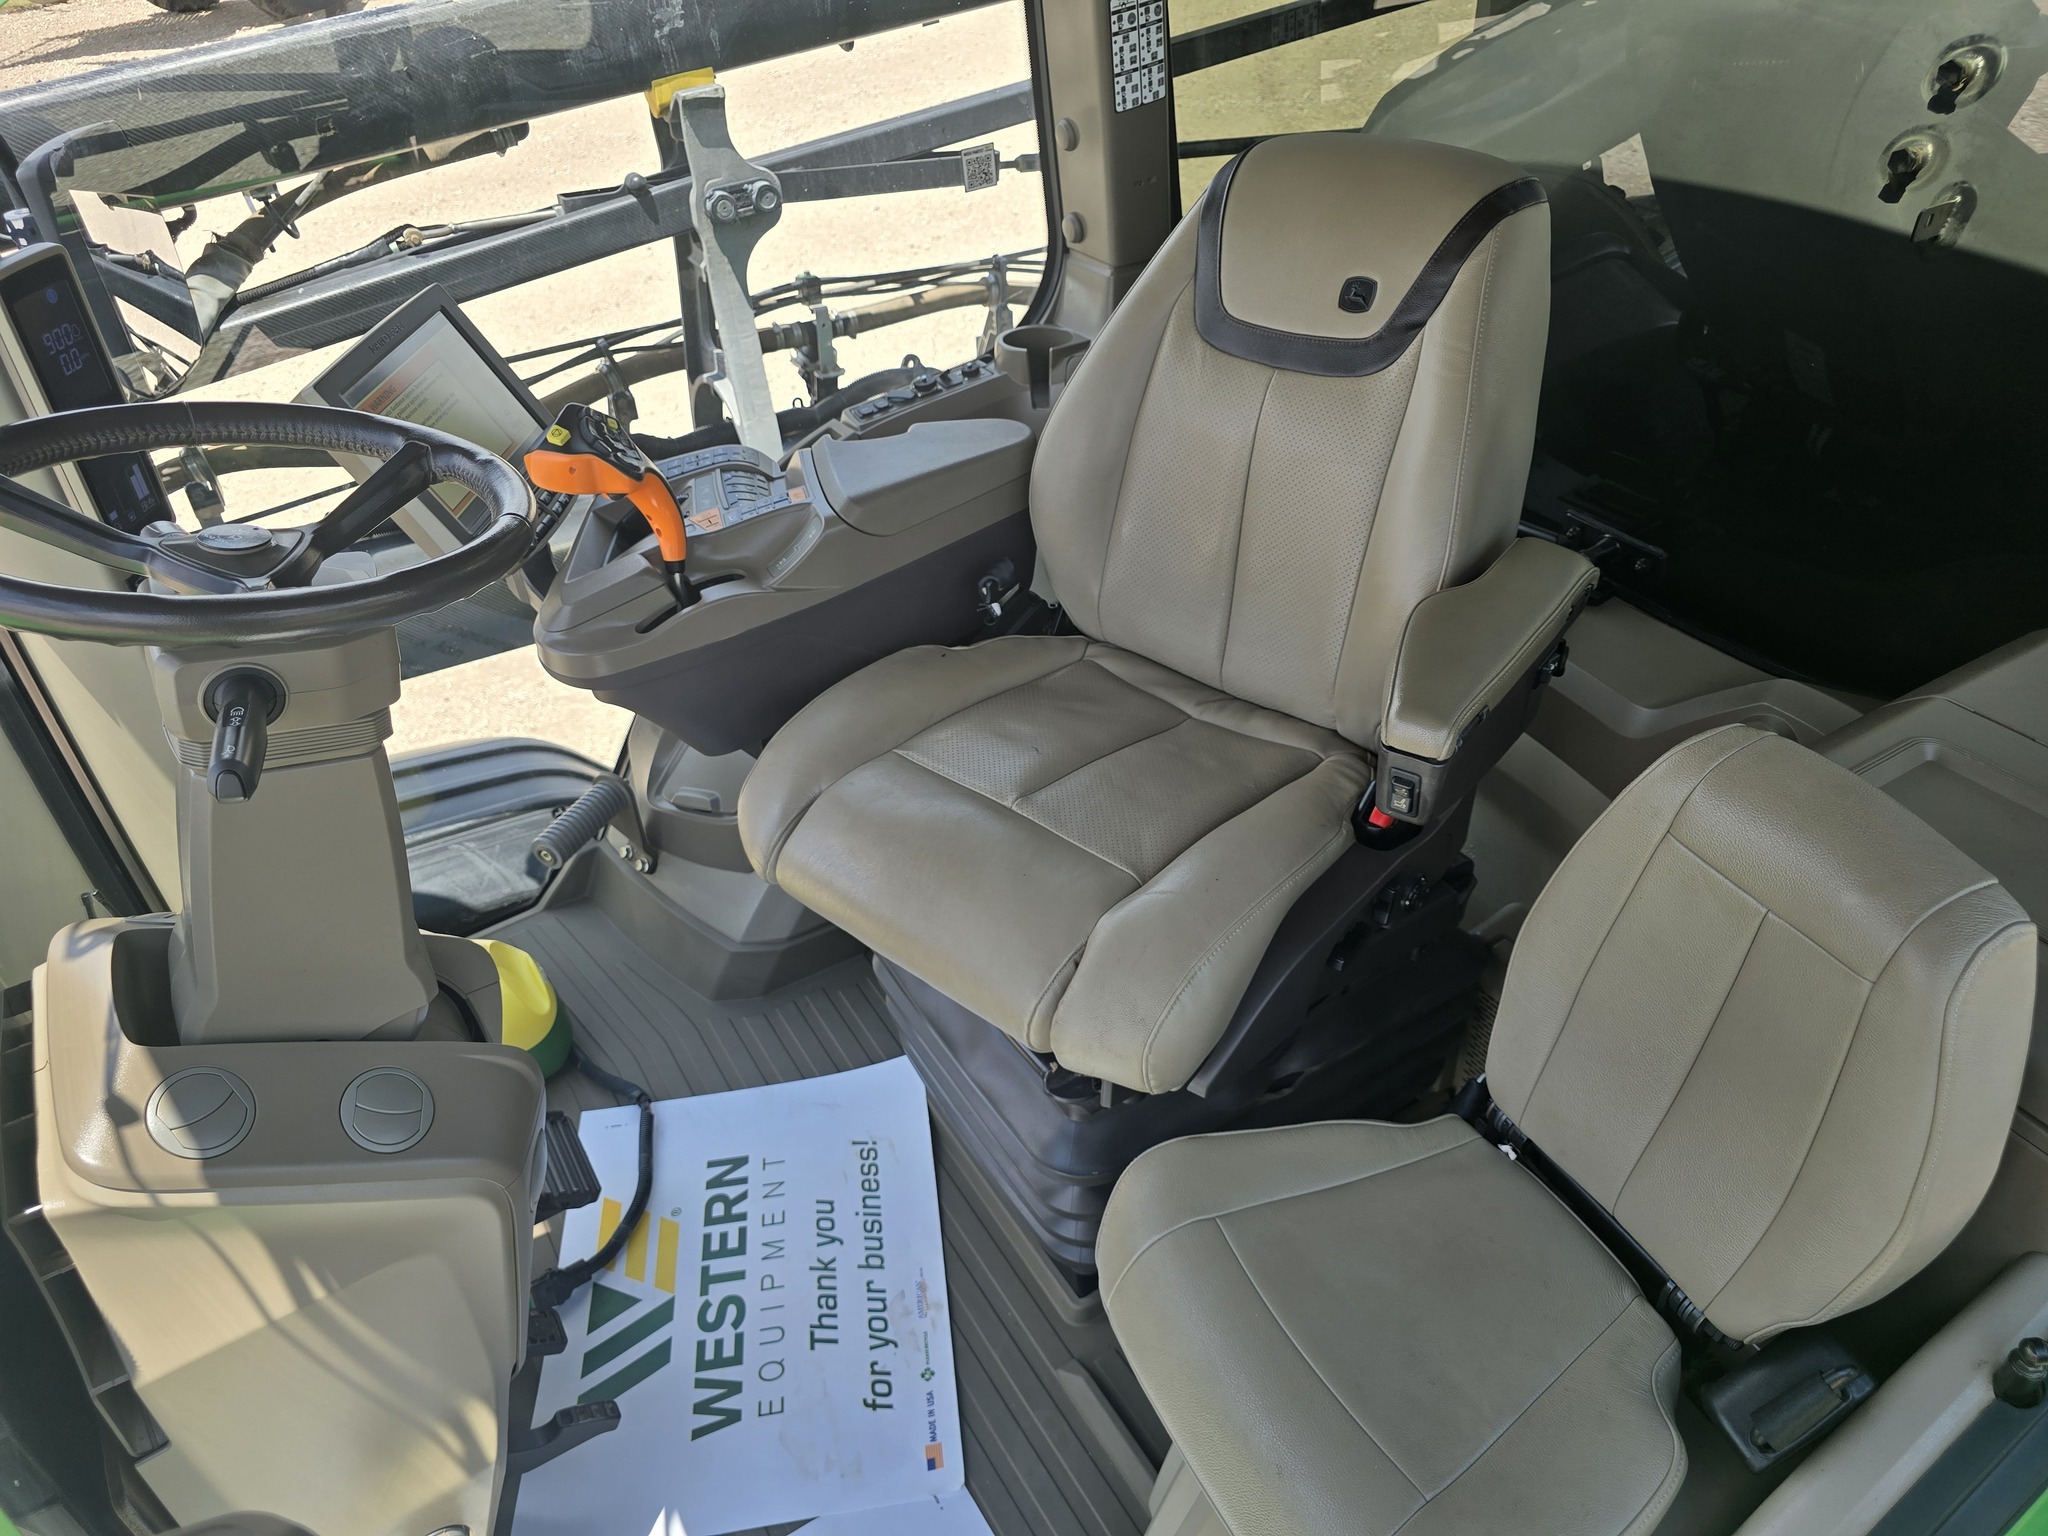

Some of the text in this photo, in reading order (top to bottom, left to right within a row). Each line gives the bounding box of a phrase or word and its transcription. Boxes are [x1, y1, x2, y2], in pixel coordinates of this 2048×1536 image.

[368, 384, 398, 411] WARNING
[691, 1154, 750, 1441] WESTERN
[758, 1157, 785, 1417] EQUIPMENT
[808, 1199, 844, 1351] Thank you
[851, 1139, 899, 1412] for your business!
[925, 1390, 938, 1442] MADE IN USA
